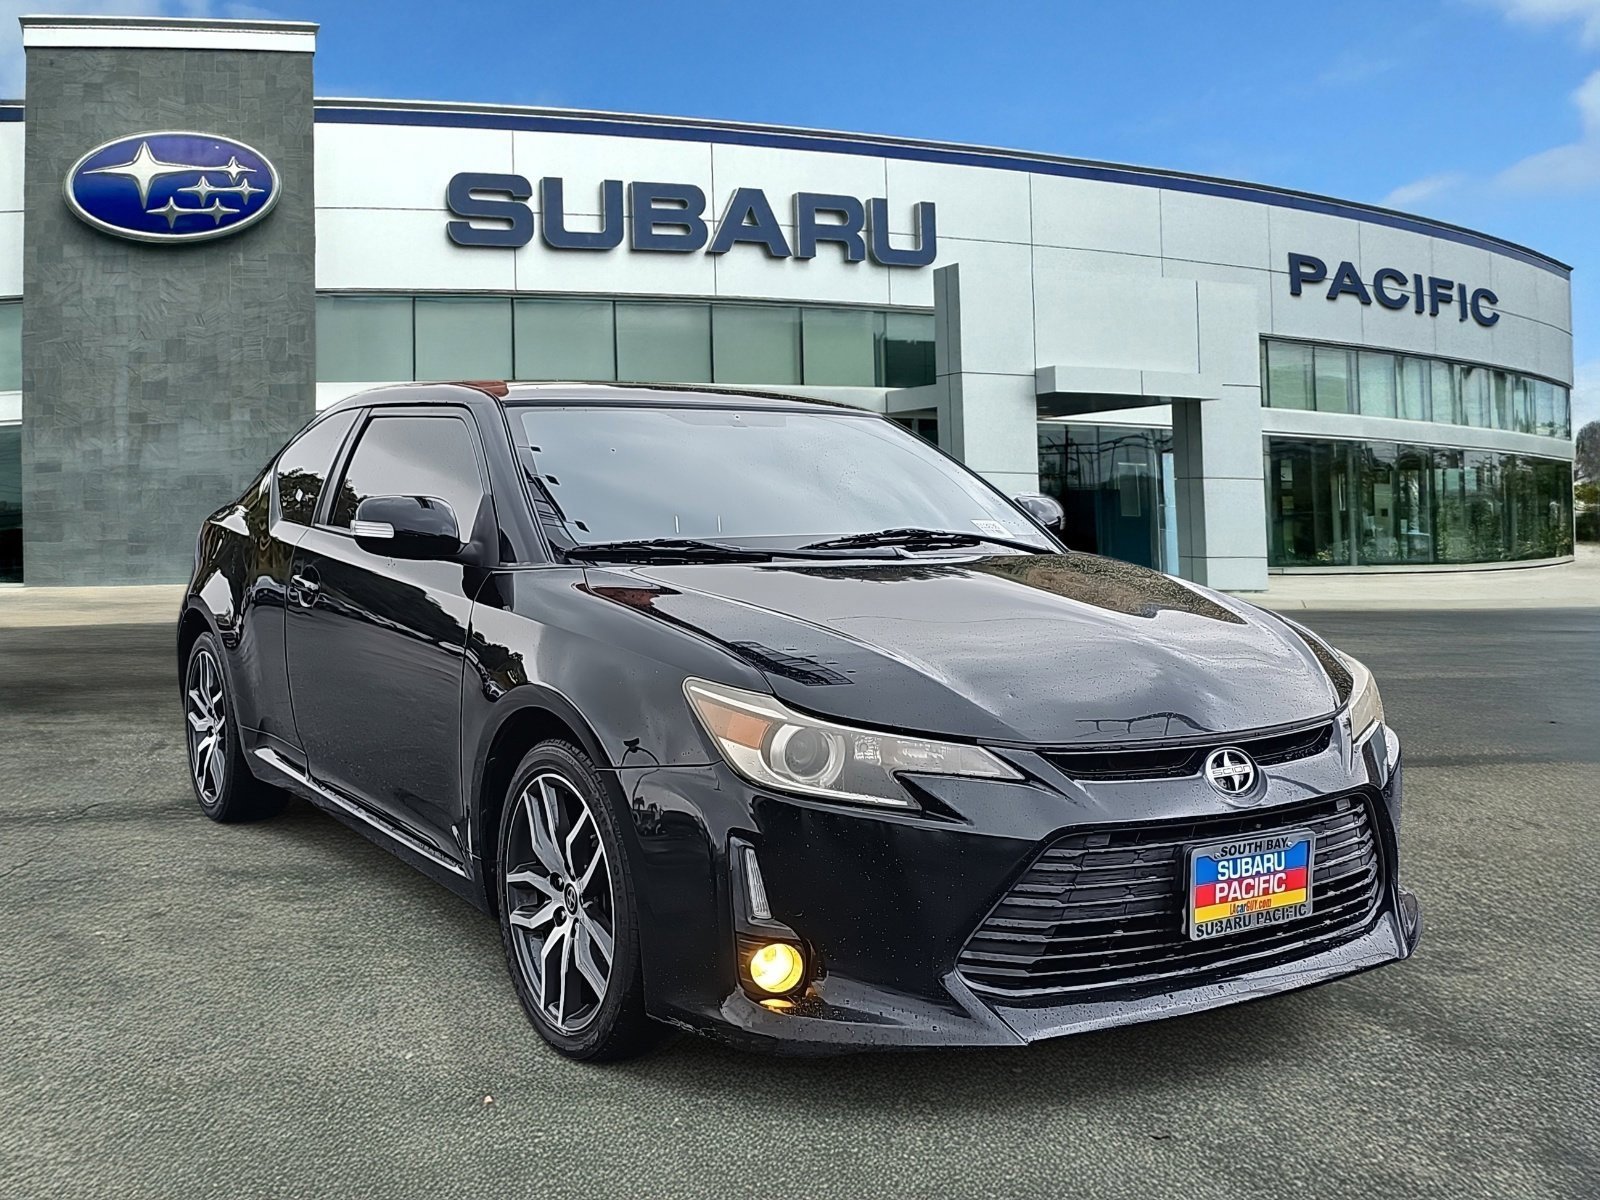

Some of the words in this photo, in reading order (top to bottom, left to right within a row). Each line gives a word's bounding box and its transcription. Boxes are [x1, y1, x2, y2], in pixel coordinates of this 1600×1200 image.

[446, 171, 937, 268] SUBARU
[1288, 251, 1500, 327] PACIFIC
[1220, 841, 1263, 858] SOUTH
[1266, 837, 1289, 851] BAY
[1217, 851, 1285, 881] SUBARU
[1215, 872, 1287, 904] PACIFIC
[1196, 914, 1251, 938] SUBARU
[1256, 903, 1307, 925] PACIFIC
